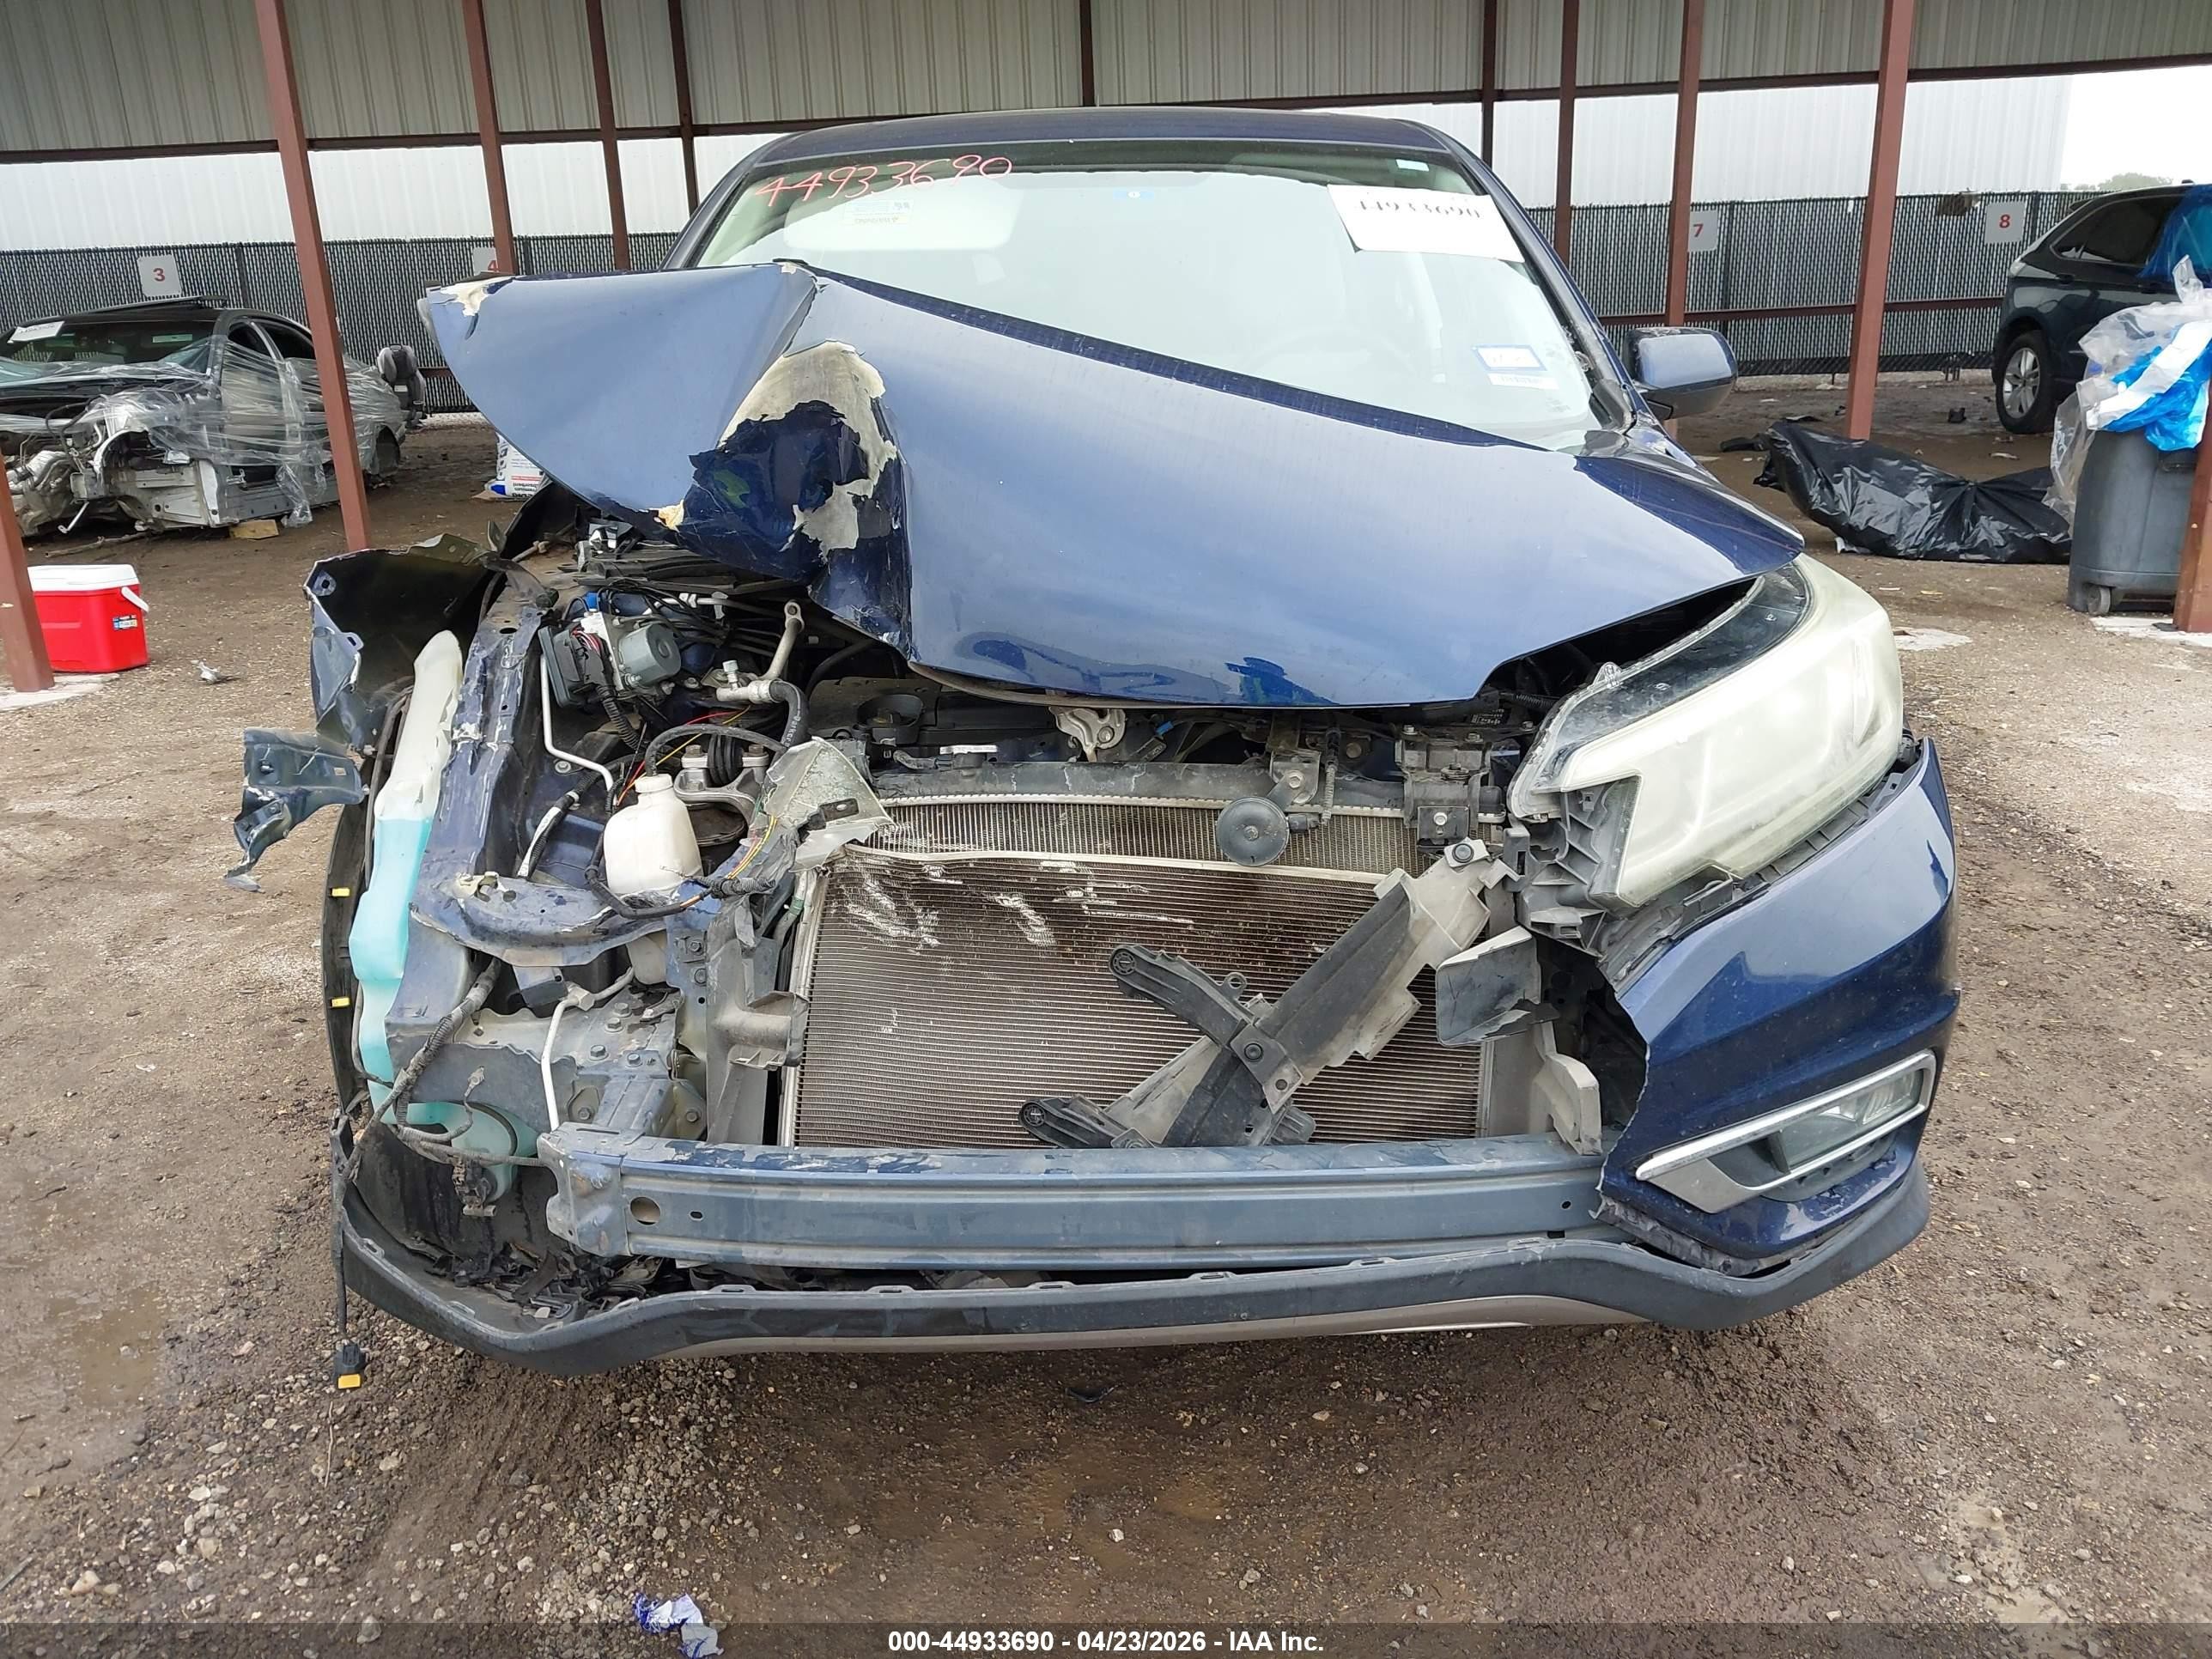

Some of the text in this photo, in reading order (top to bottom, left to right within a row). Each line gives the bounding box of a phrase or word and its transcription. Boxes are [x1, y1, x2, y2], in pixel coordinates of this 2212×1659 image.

[755, 154, 1012, 207] 44933690
[1999, 214, 2010, 228] 8
[1692, 223, 1704, 237] 7
[153, 267, 166, 282] 3
[786, 715, 801, 742] Parker
